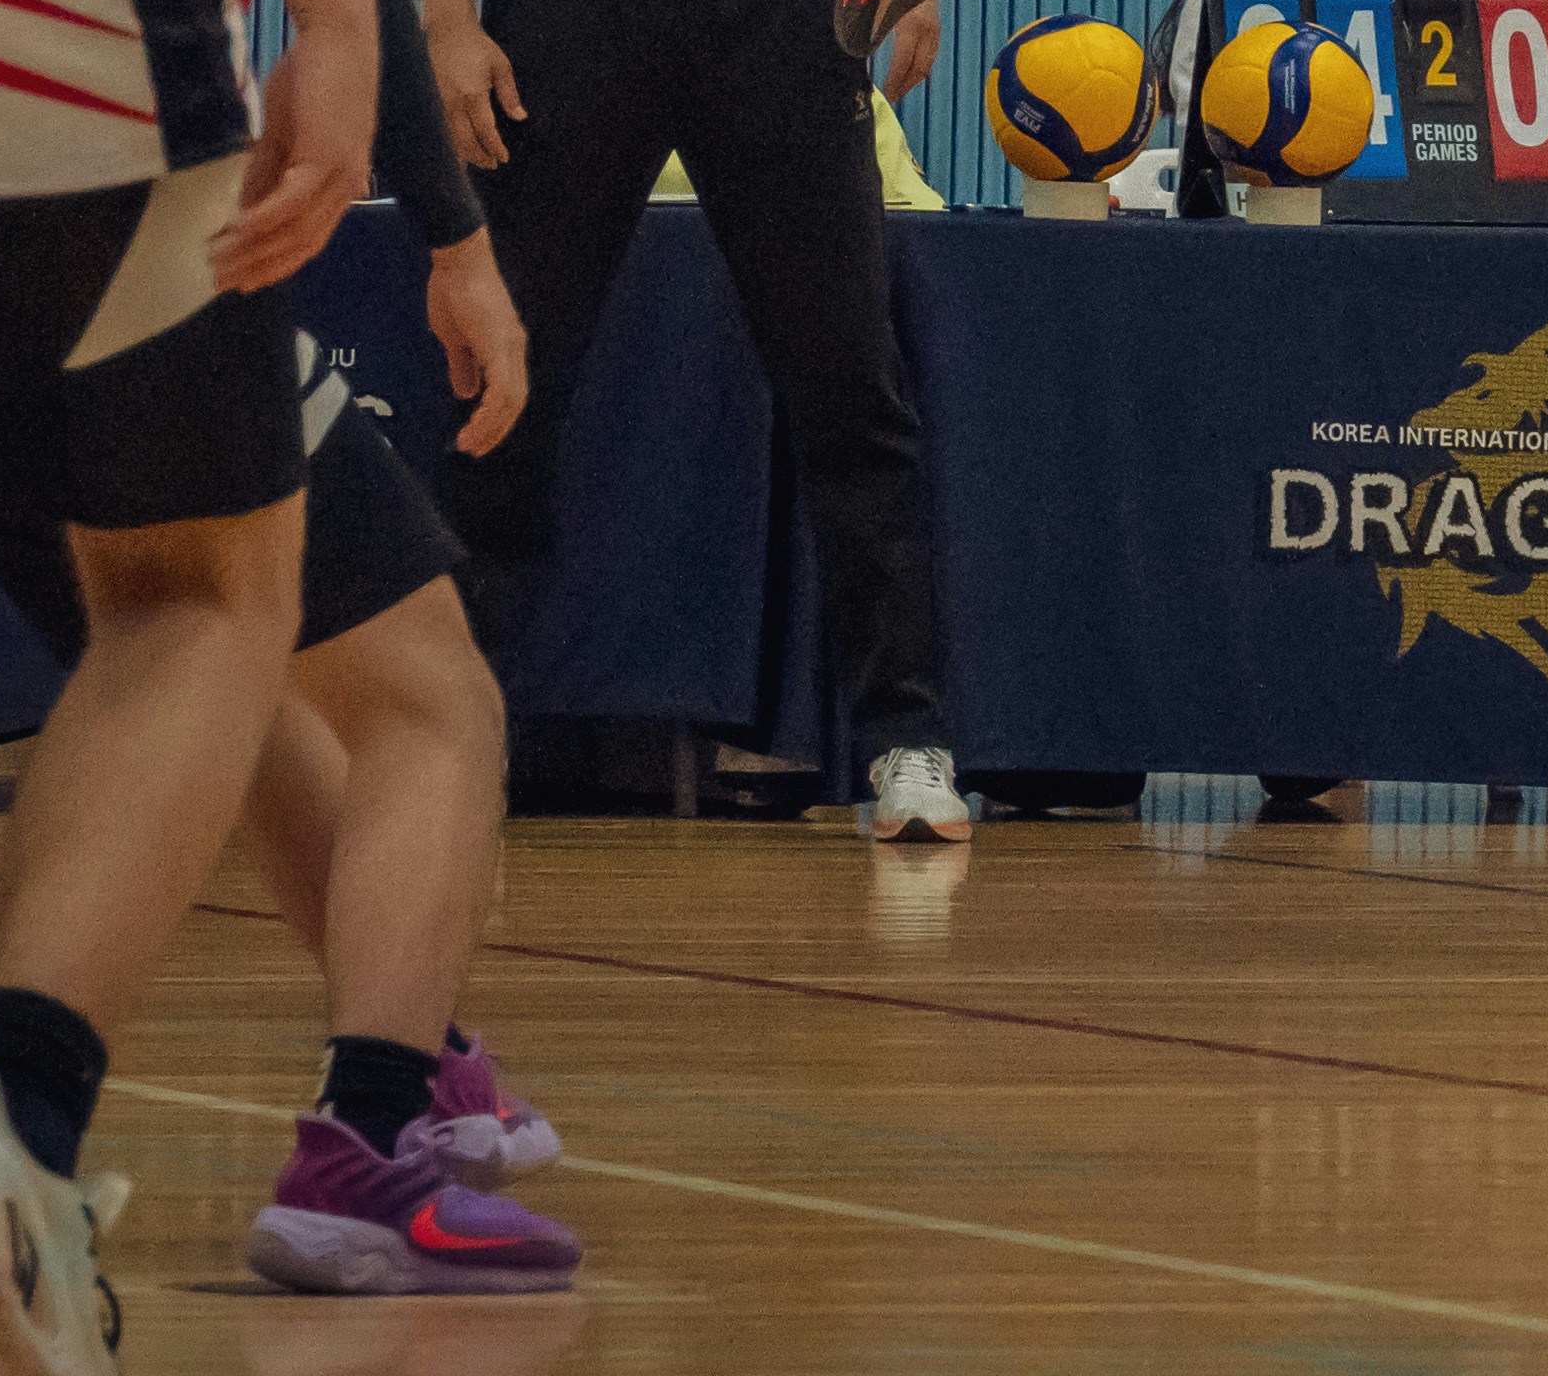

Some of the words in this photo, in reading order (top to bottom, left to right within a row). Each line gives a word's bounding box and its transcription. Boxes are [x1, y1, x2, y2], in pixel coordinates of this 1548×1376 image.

[1421, 20, 1458, 86] 2
[1411, 123, 1478, 143] PERIOD
[1415, 143, 1478, 162] GAMES
[1311, 421, 1391, 444] KOREA
